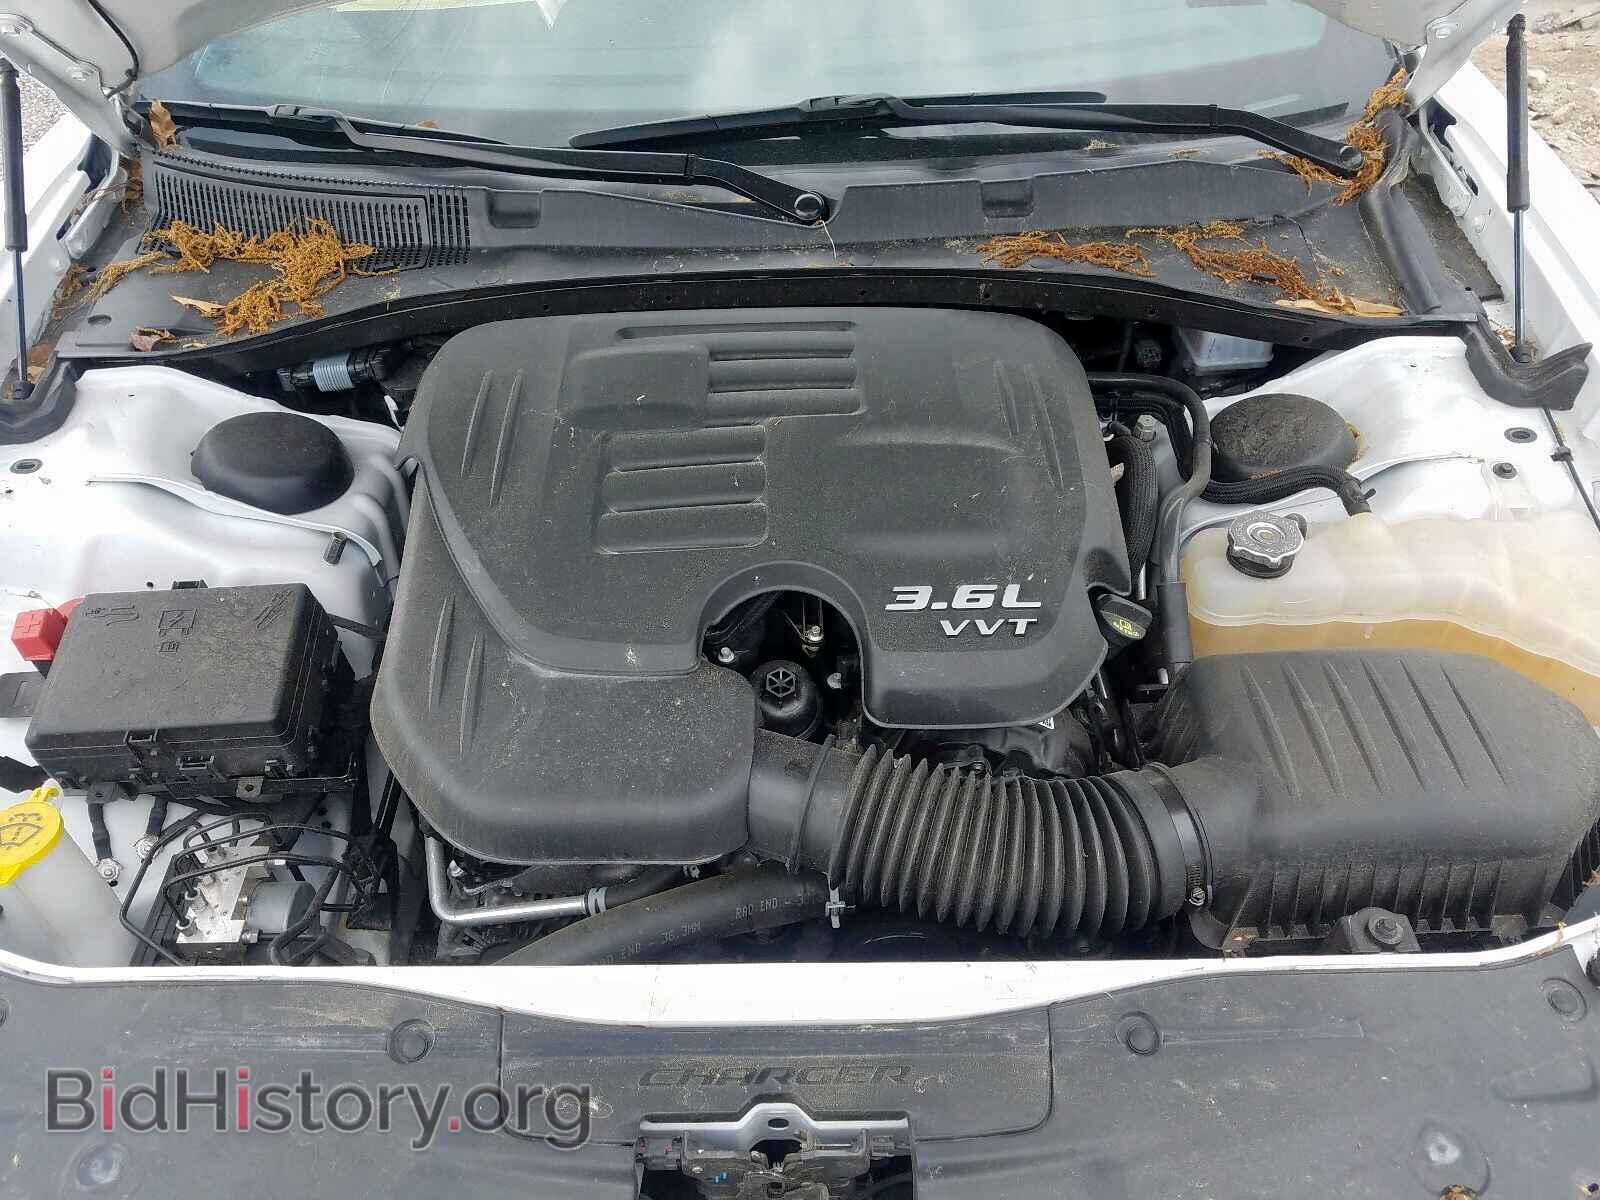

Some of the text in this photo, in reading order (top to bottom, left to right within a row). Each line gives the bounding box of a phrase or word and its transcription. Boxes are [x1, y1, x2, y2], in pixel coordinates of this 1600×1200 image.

[885, 584, 1042, 611] 3.6L
[940, 618, 1038, 636] VVT
[637, 1065, 912, 1087] CHARGER
